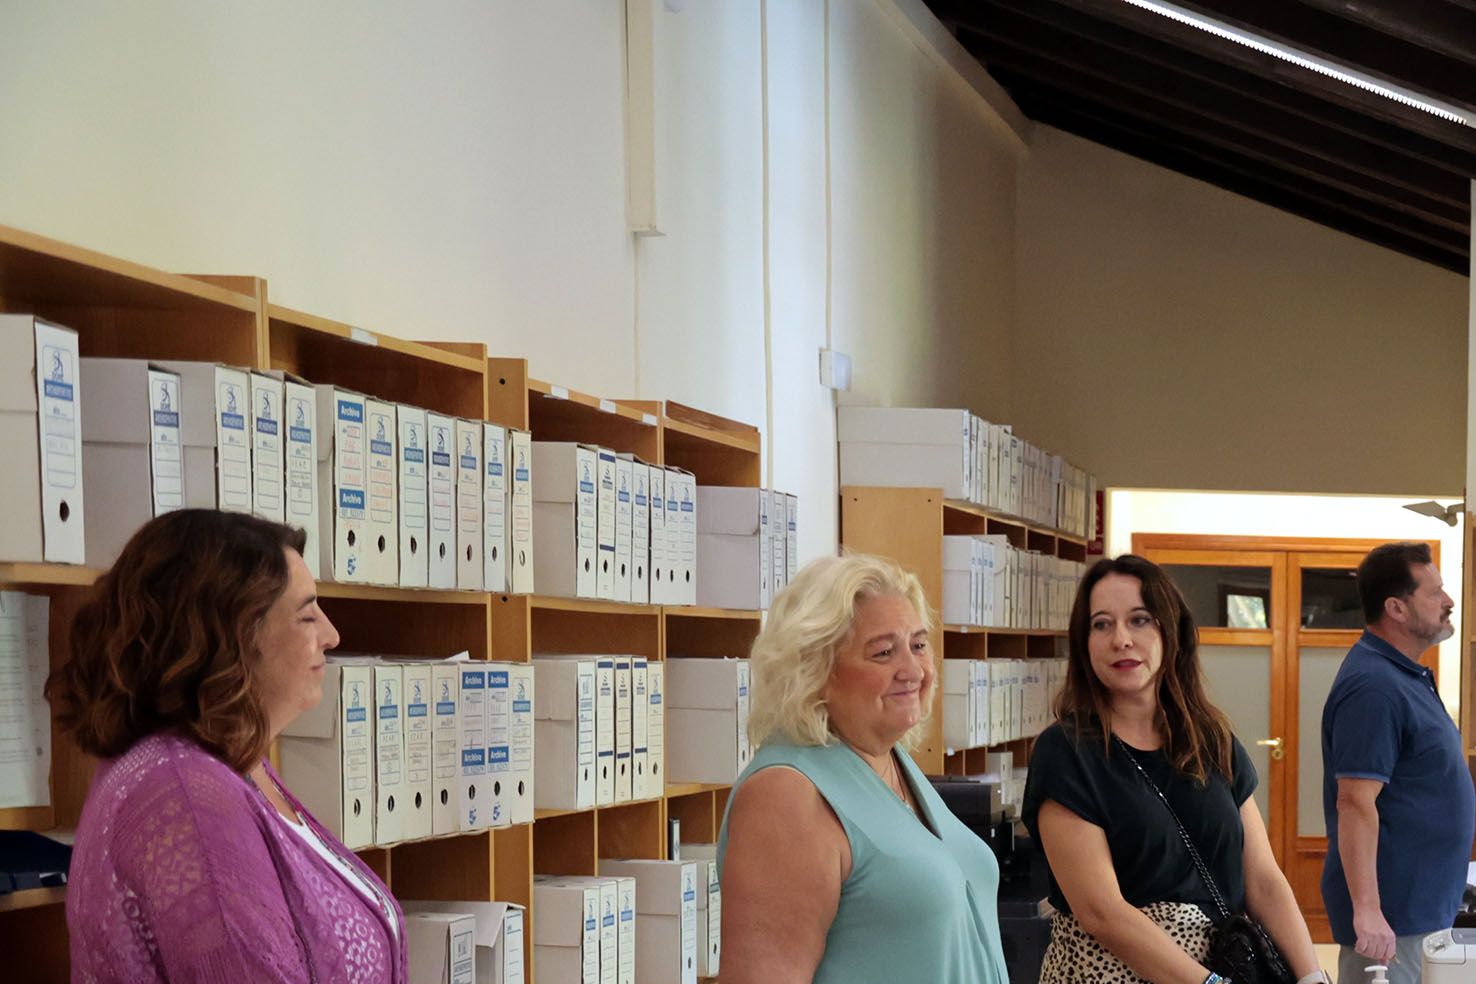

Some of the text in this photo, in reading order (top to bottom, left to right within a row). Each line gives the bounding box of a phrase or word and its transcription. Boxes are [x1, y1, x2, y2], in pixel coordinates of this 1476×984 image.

[341, 403, 360, 418] Archivo
[343, 494, 362, 505] Archivo
[465, 676, 482, 685] Archivo
